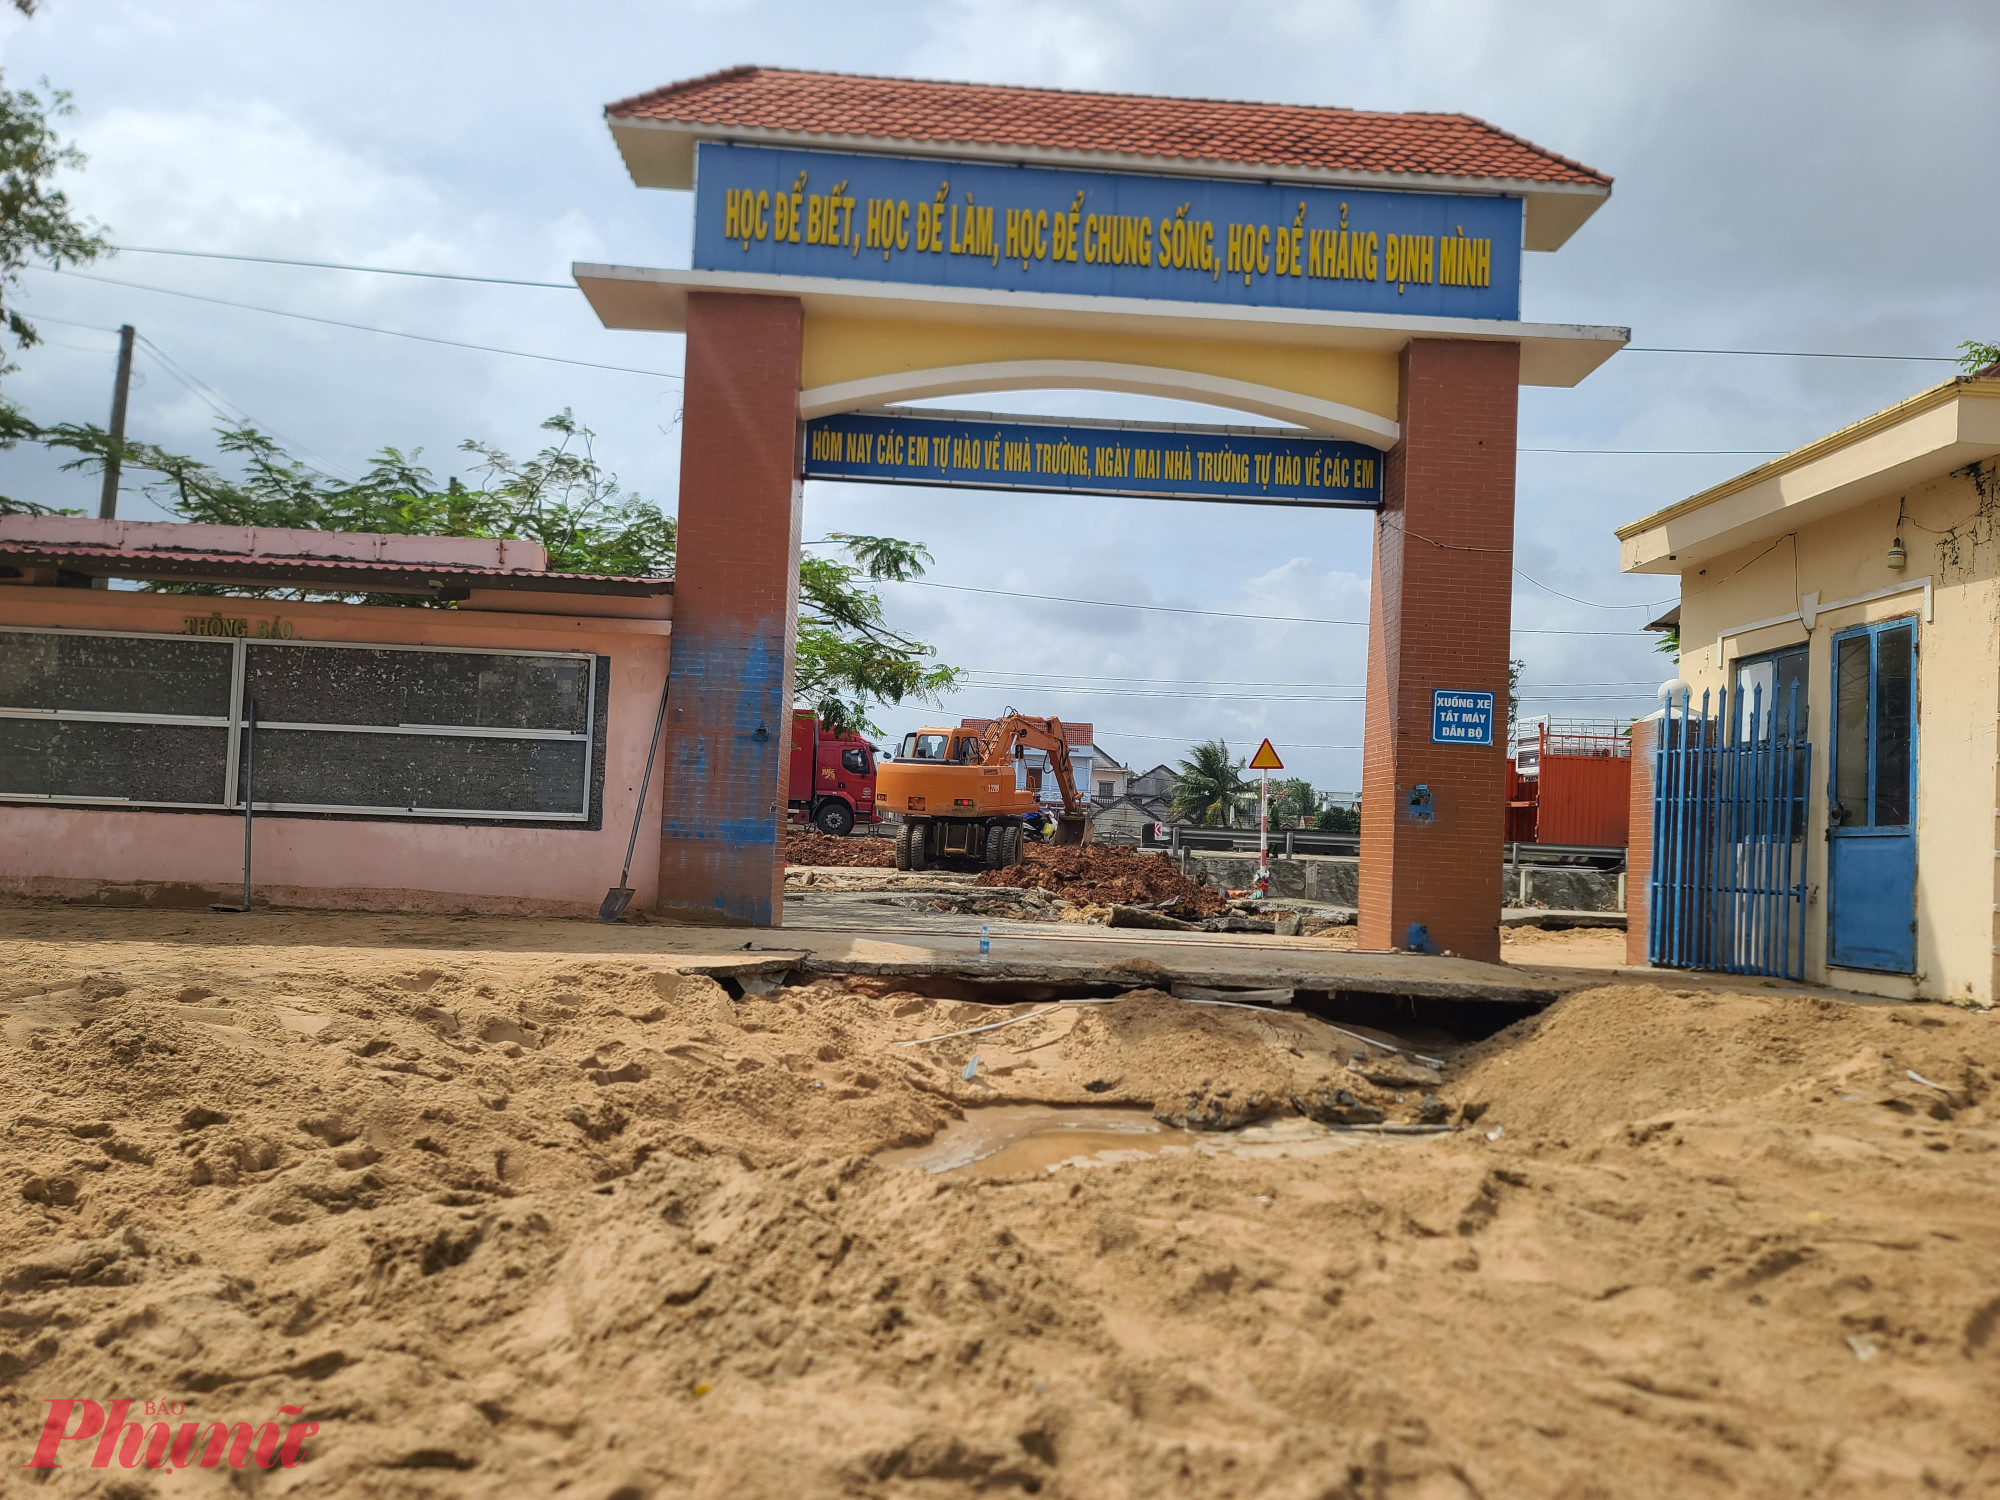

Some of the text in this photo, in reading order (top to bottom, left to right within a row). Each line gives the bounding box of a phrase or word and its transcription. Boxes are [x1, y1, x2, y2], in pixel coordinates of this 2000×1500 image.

[725, 170, 1491, 294] HỌC ĐỂ BIẾT, HỌC ĐỂ LÀM, HỌC ĐỂ CHUNG SỐNG, HỌC ĐỂ KHẲNG ĐỊNH MÌNH
[812, 424, 1374, 490] HÔM NAY CÁC EM TỰ HÀO VỀ NHÀ TRƯỜNG, NGÀY MAI NHÀ TRƯỜNG TỰ HÀO VỀ CÁC EM
[183, 612, 293, 640] THÔNG BÁO
[1436, 695, 1491, 709] XUỐNG XE
[1462, 712, 1486, 723] MÁY
[1467, 727, 1483, 740] BỘ
